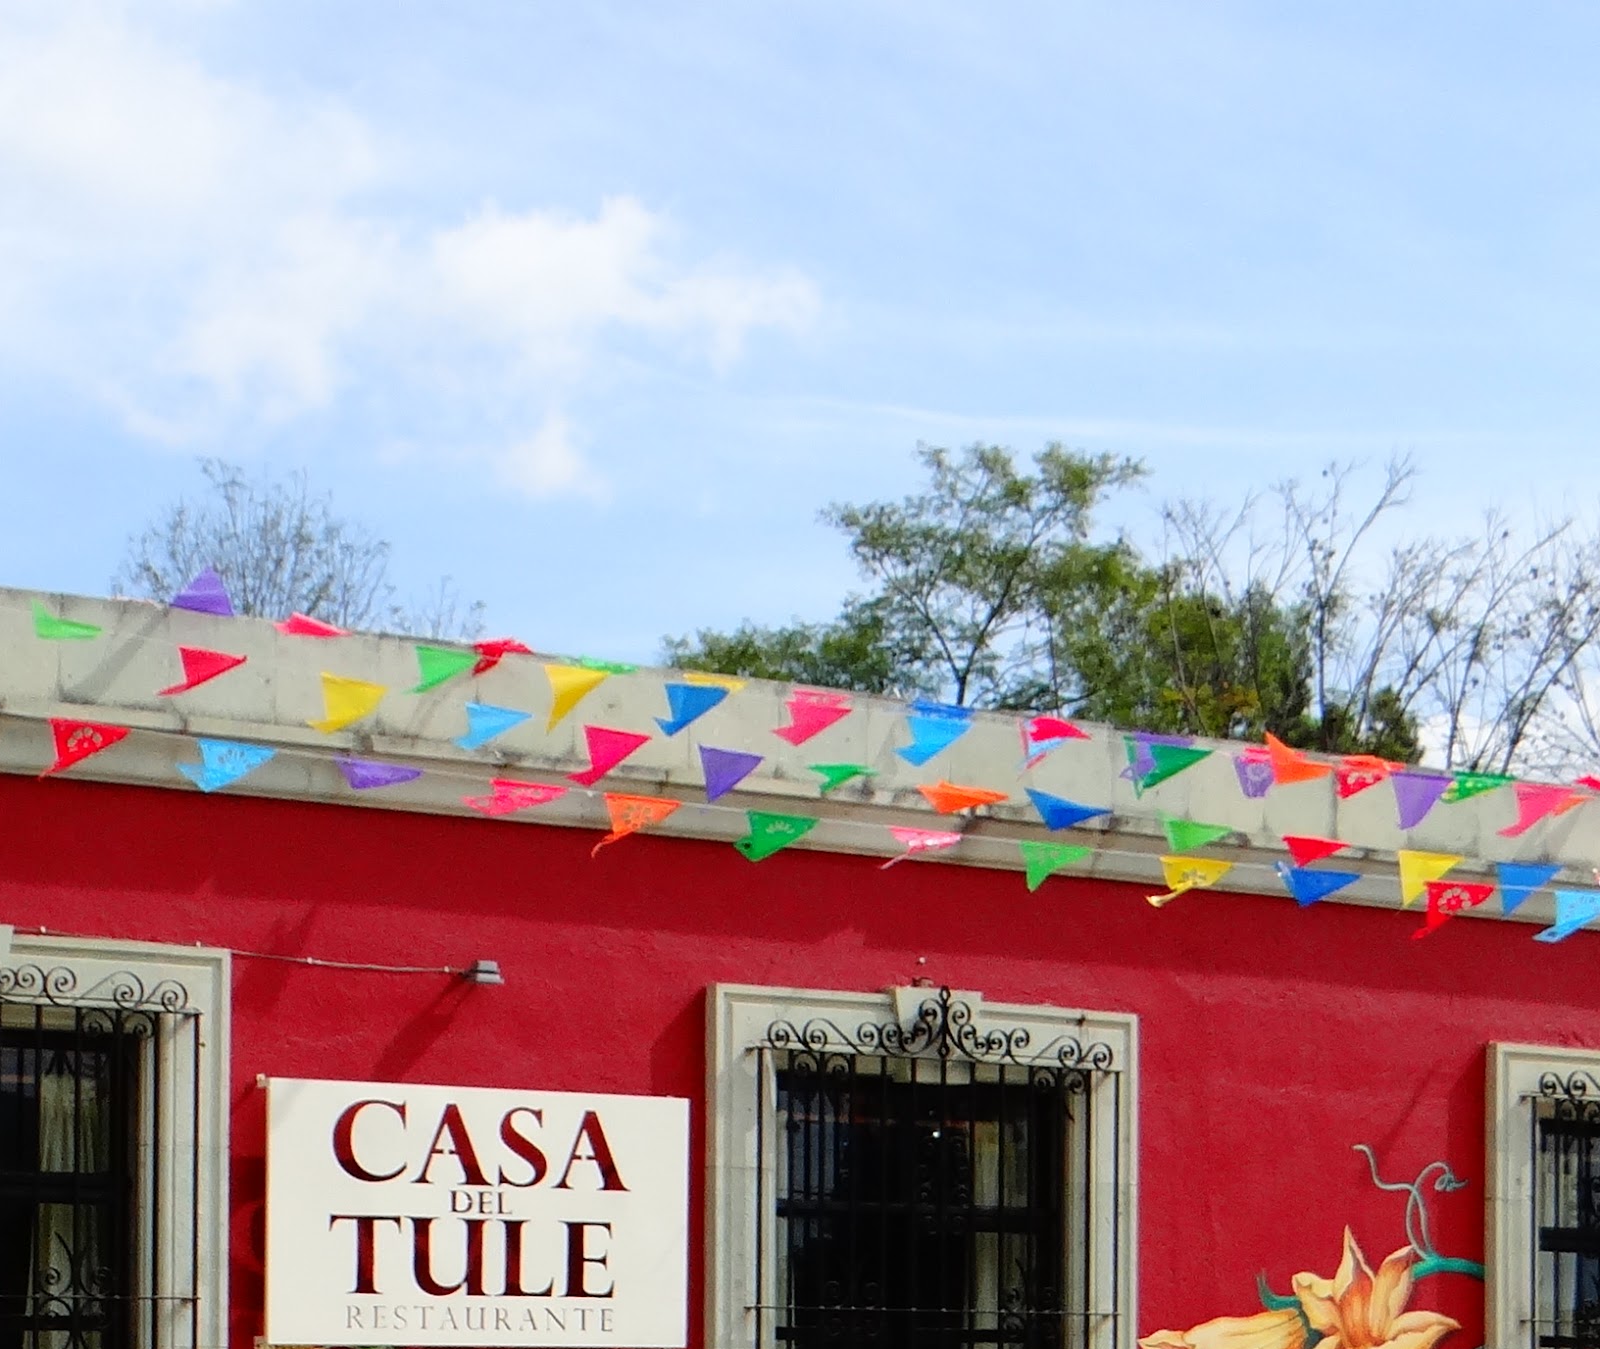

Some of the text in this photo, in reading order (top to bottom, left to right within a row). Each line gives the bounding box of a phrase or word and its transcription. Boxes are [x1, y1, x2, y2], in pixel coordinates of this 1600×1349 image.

[332, 1099, 631, 1192] CASA
[450, 1190, 512, 1215] DEL
[329, 1214, 615, 1299] TULE
[346, 1304, 614, 1332] RESTAURANTE
